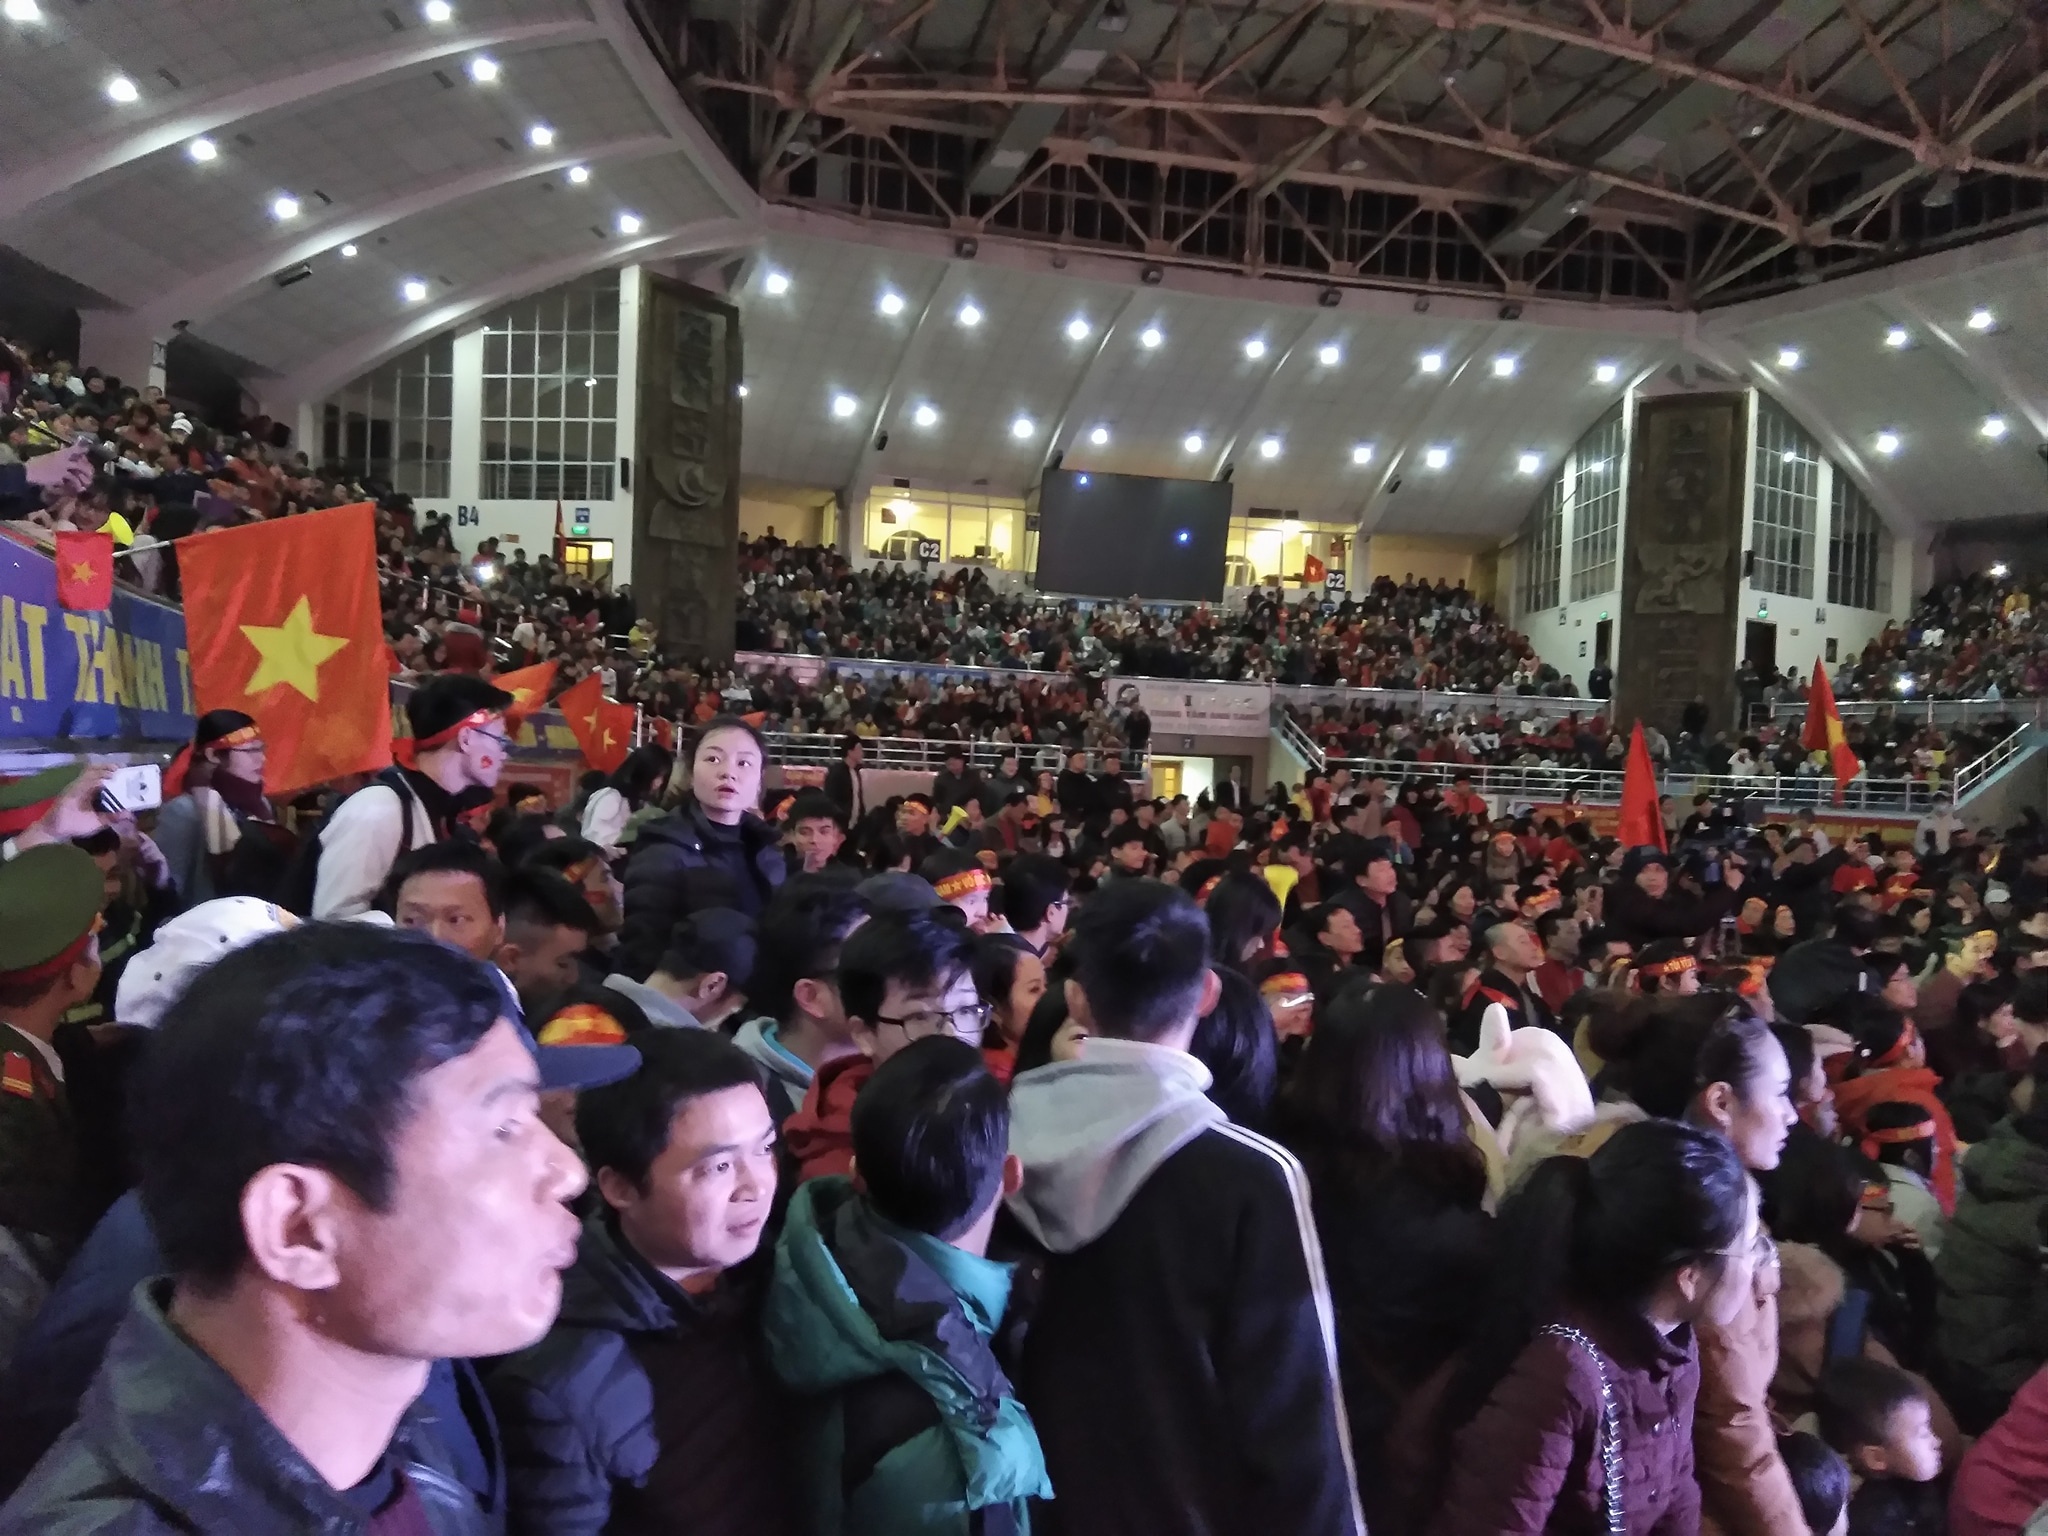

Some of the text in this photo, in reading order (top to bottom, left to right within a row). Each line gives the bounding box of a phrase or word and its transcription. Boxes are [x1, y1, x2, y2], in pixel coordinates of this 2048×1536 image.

[458, 505, 479, 527] B4
[919, 541, 940, 558] C2
[1325, 572, 1345, 588] C2
